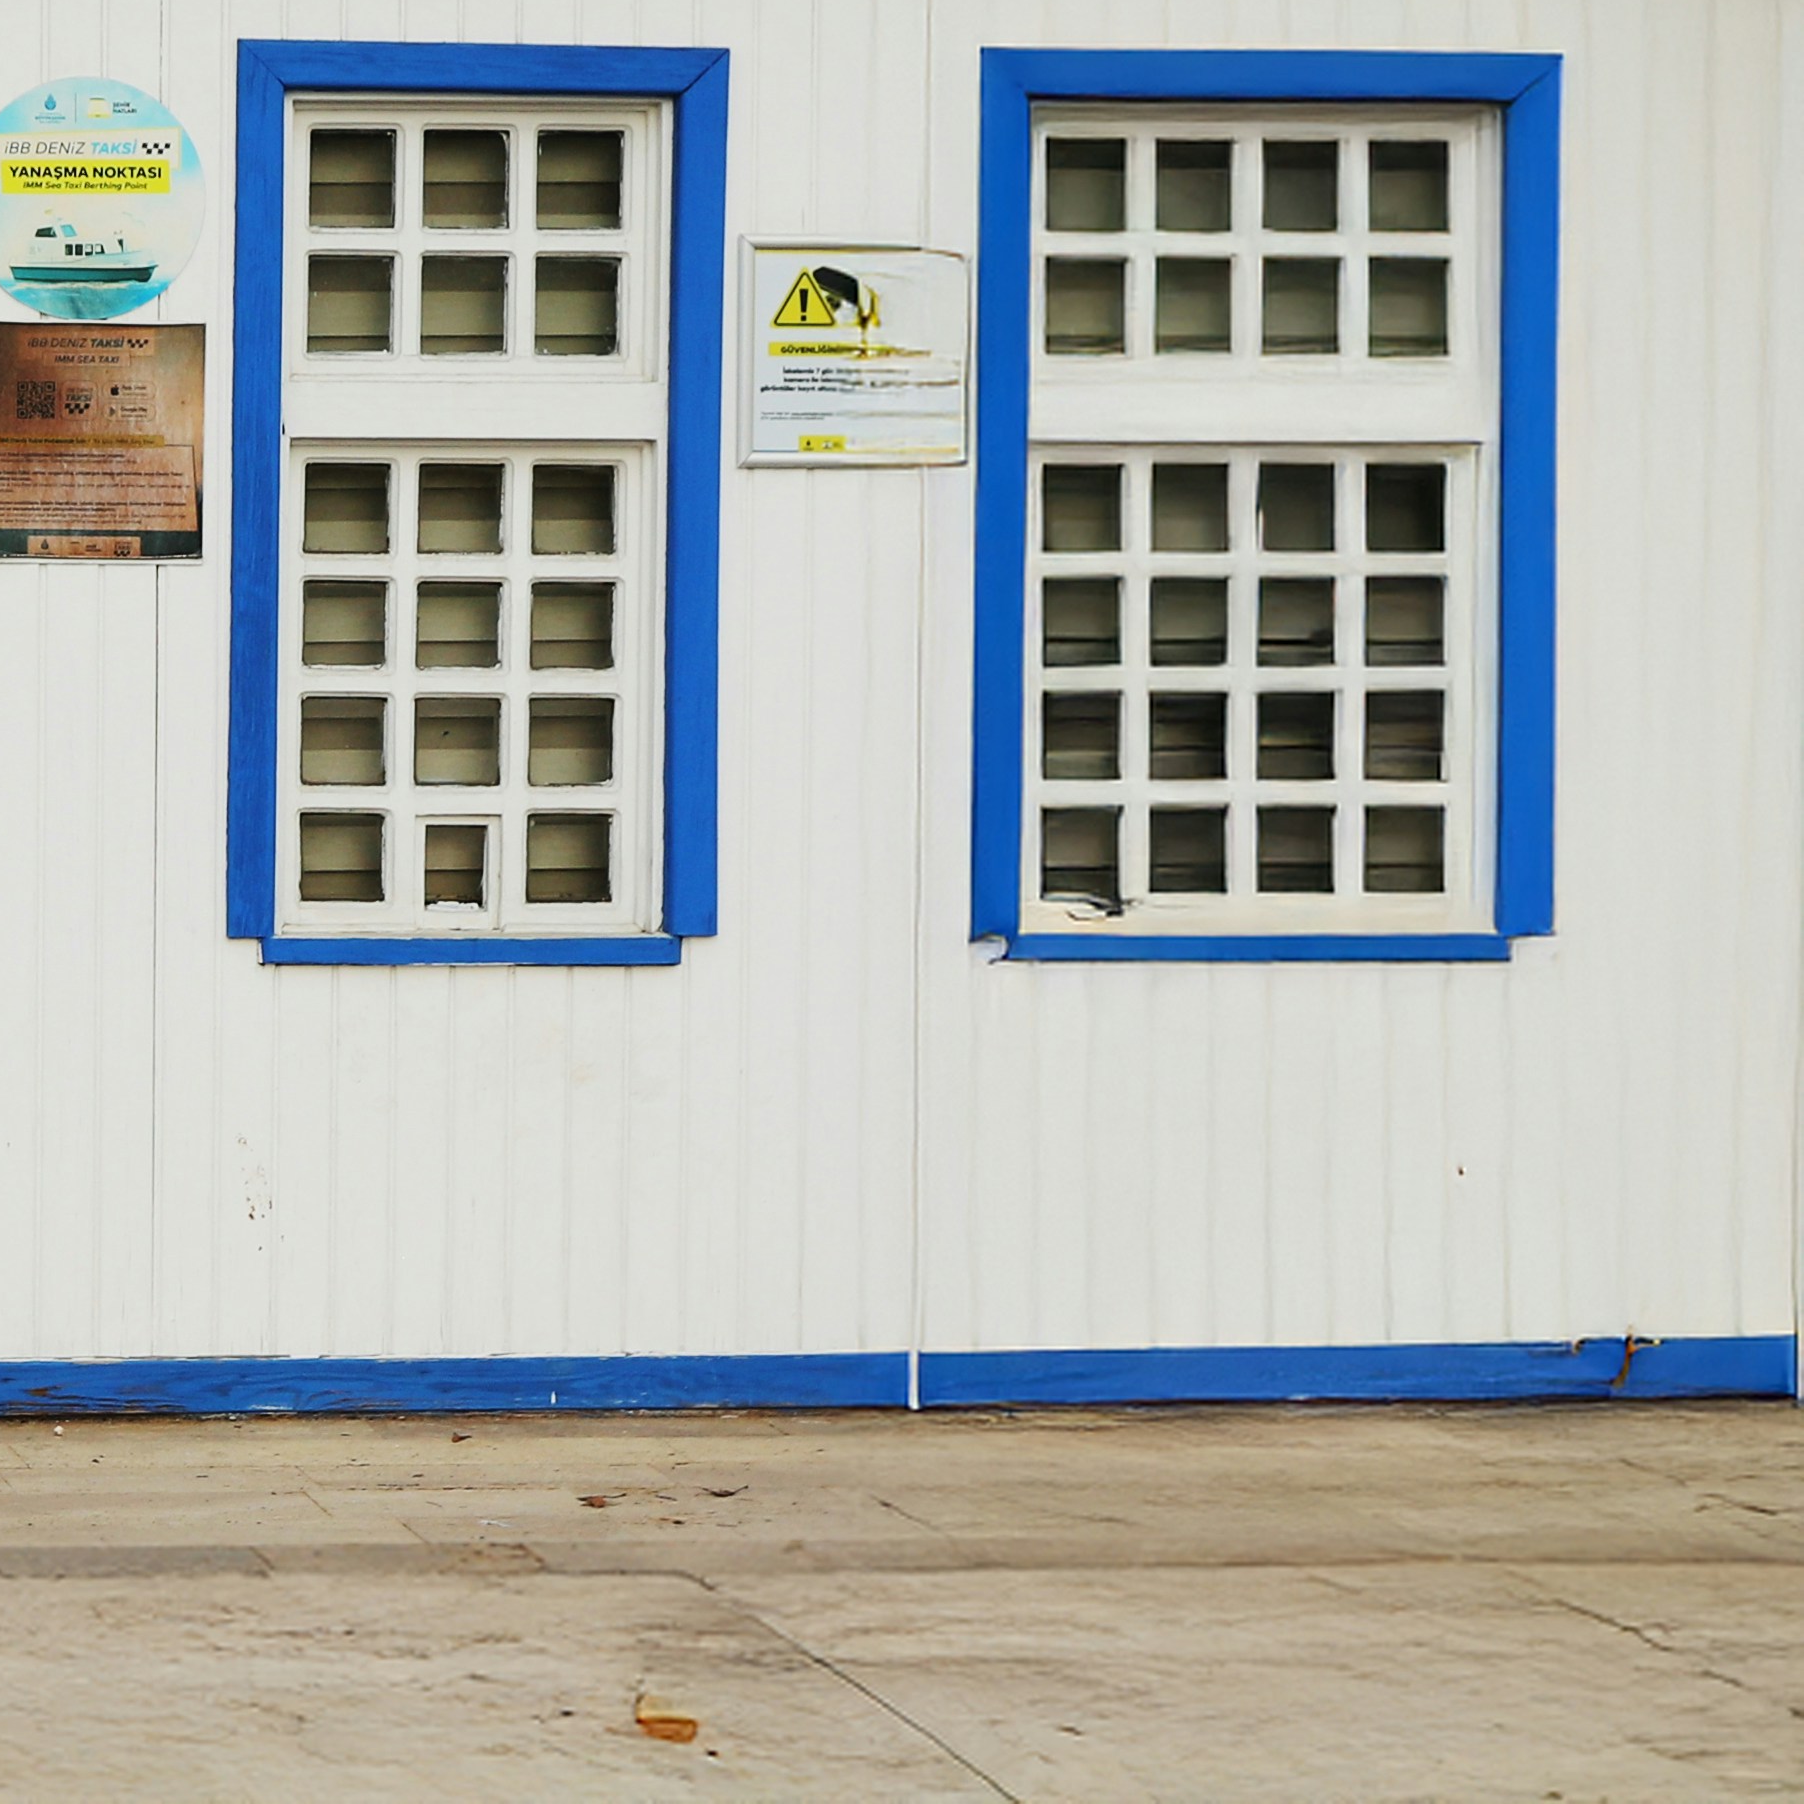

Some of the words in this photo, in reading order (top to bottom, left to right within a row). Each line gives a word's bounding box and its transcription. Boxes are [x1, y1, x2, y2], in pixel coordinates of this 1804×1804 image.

[9, 166, 89, 180] YANAŞMA
[93, 166, 162, 179] NOKTASI
[84, 182, 123, 190] Berthing
